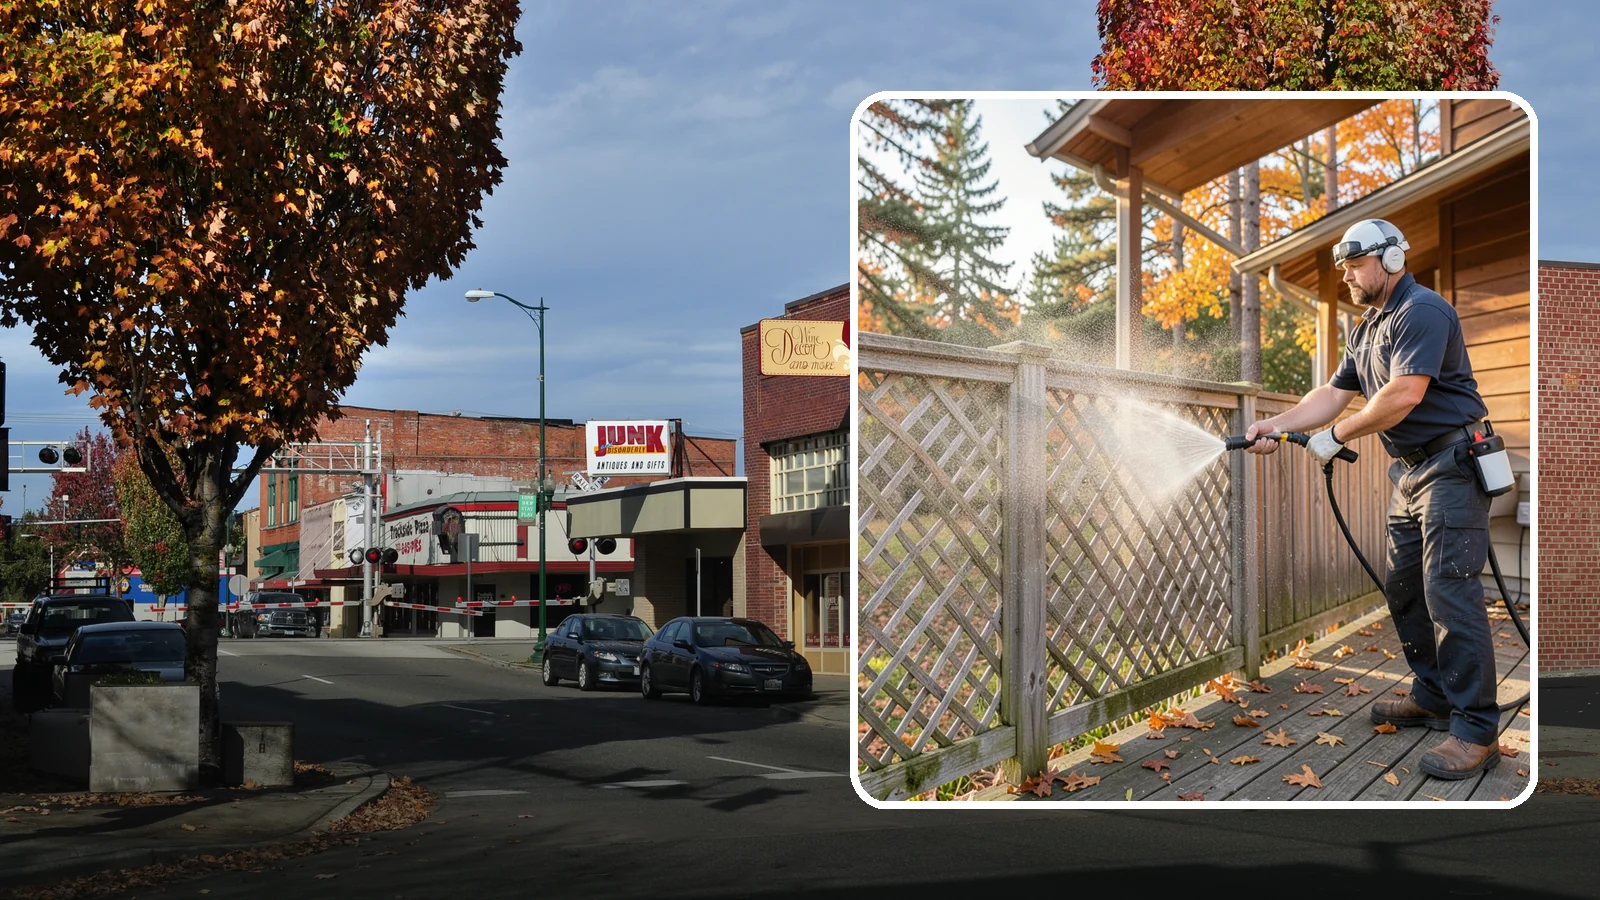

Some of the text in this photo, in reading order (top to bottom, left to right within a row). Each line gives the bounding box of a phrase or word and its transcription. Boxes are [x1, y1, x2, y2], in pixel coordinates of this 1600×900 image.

[595, 425, 665, 457] JUNK
[607, 446, 646, 454] DISORDERLY
[597, 460, 665, 470] ANTIQUES AND GIFTS
[390, 520, 429, 540] Trackside Pizza
